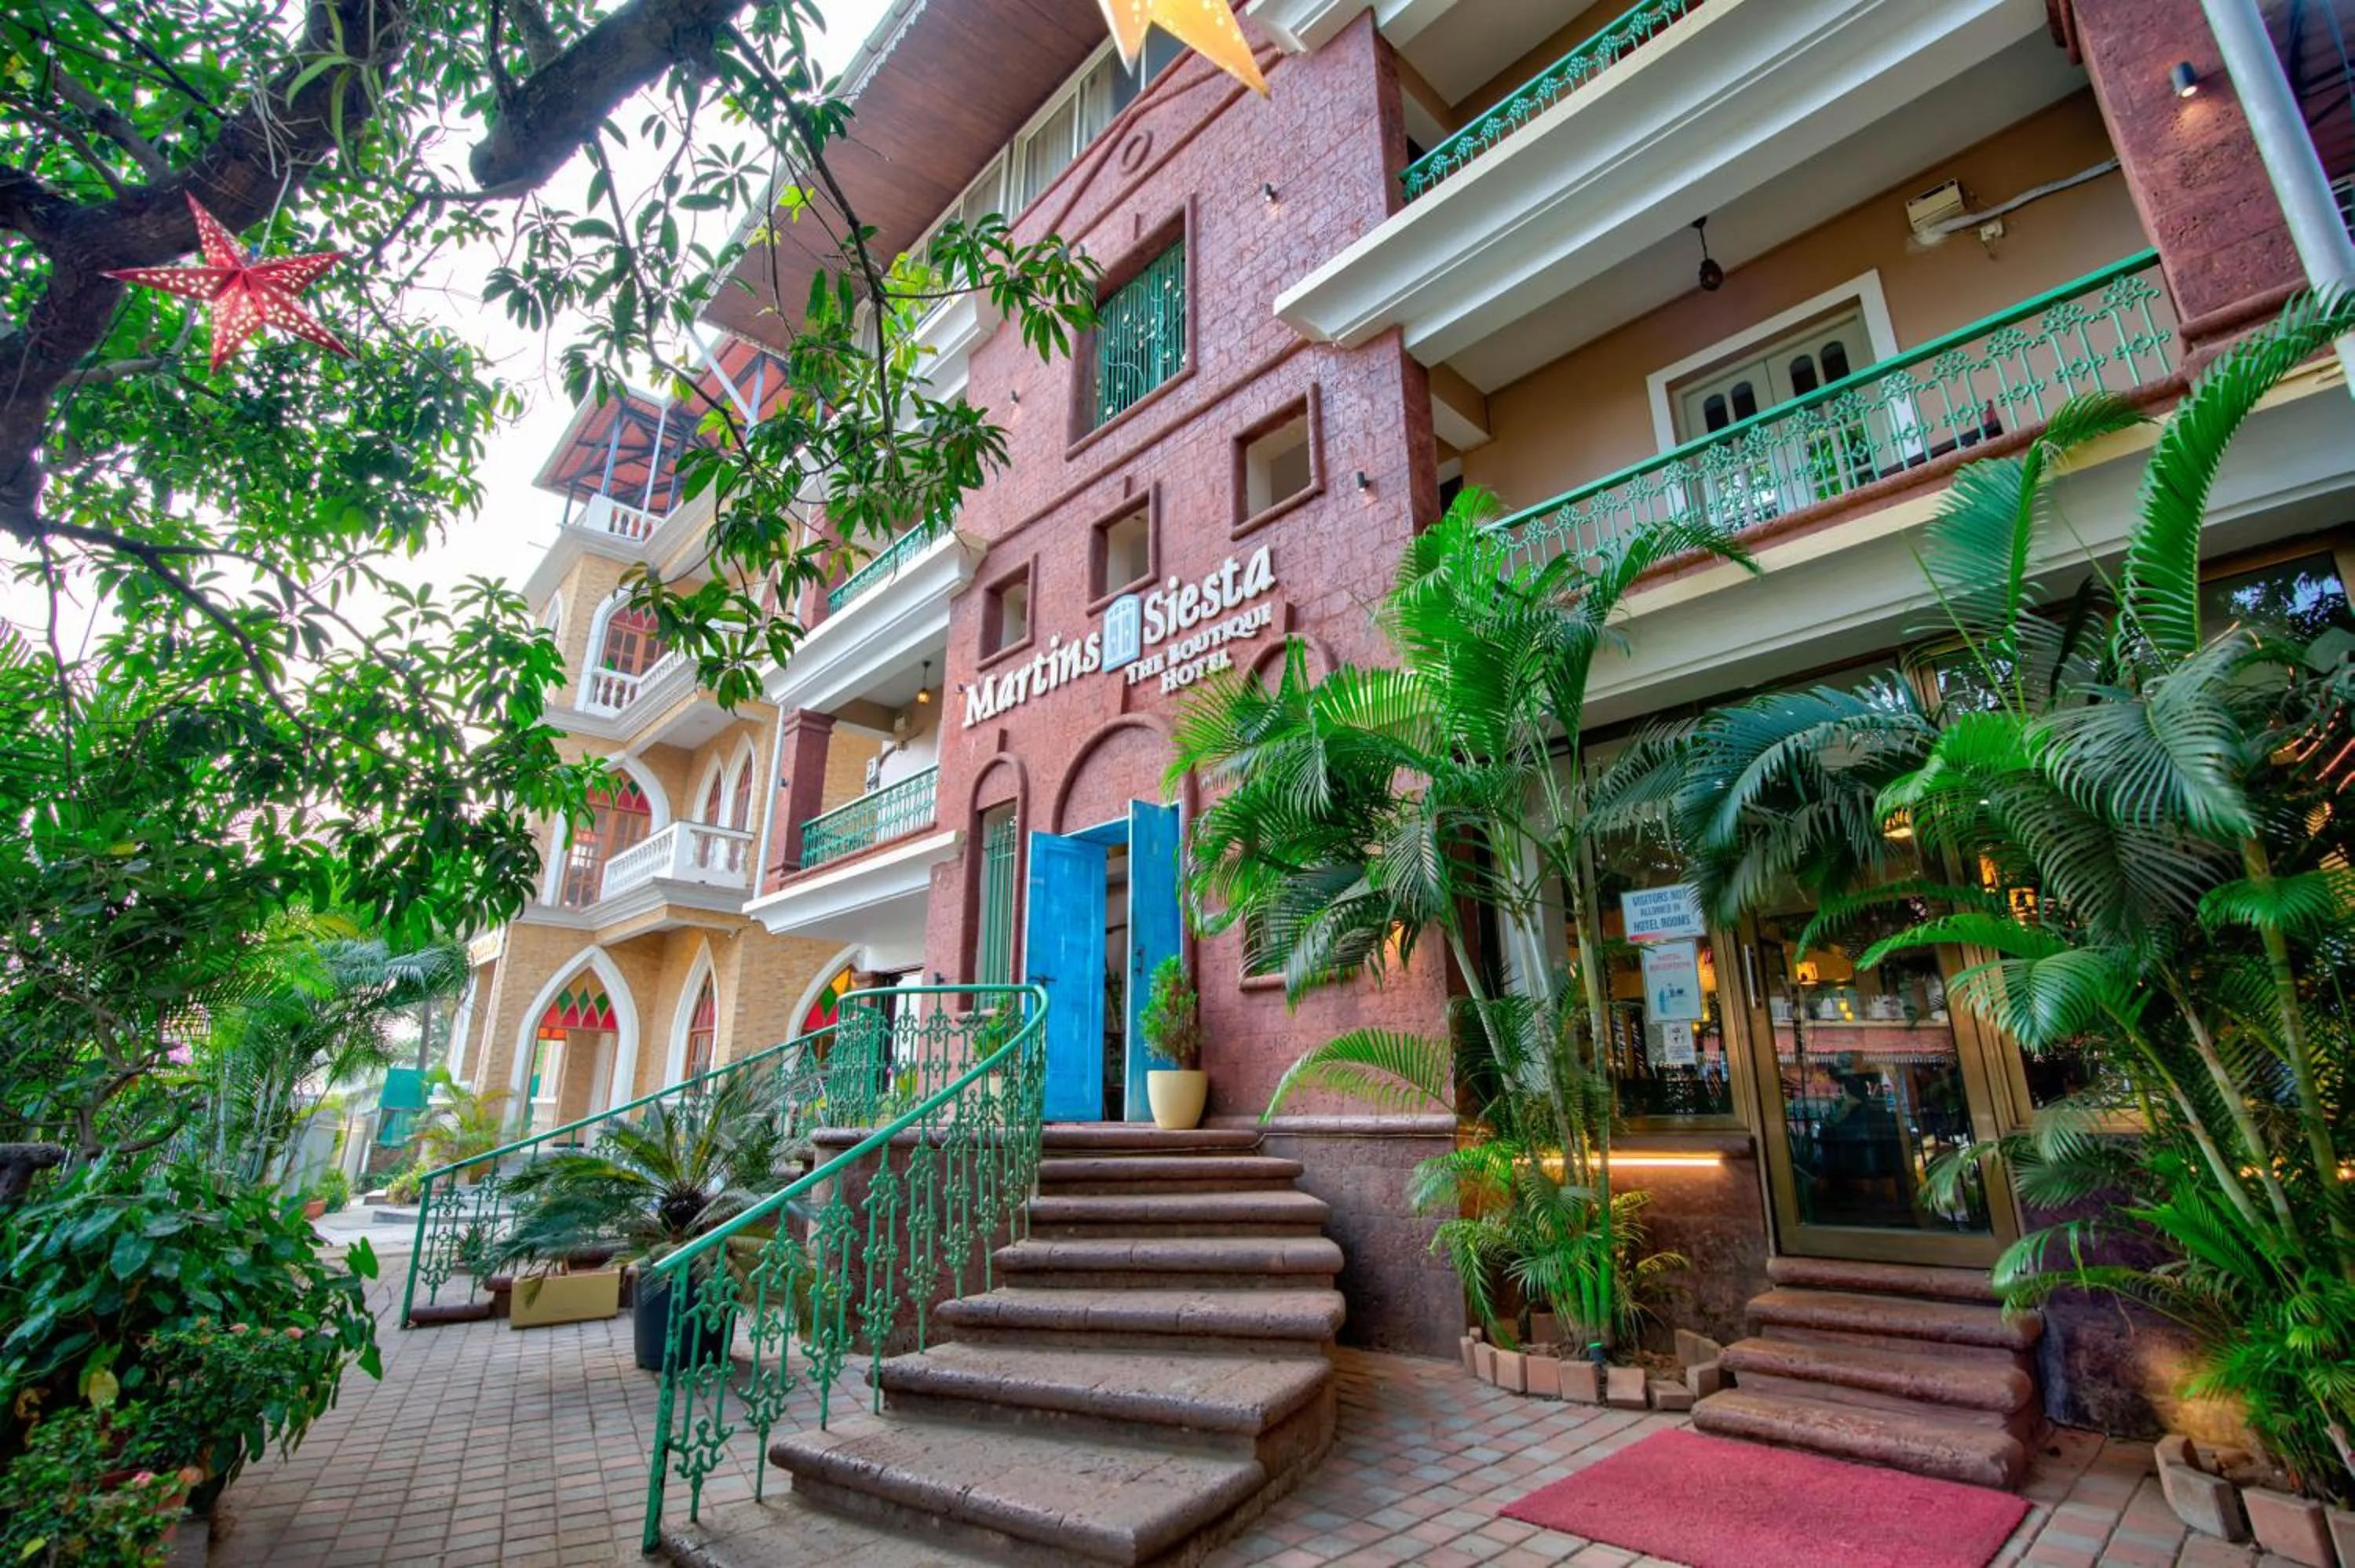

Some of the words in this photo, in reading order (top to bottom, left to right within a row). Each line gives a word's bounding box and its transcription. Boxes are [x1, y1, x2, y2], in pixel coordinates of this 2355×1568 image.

[962, 631, 1101, 728] Martins
[1143, 545, 1276, 645] Siesta
[1125, 653, 1165, 684] THE
[1167, 602, 1272, 665] BOUTIQUE
[1160, 647, 1232, 694] HOTEL
[1633, 919, 1659, 933] HOTEL
[1661, 914, 1691, 928] ROOMS
